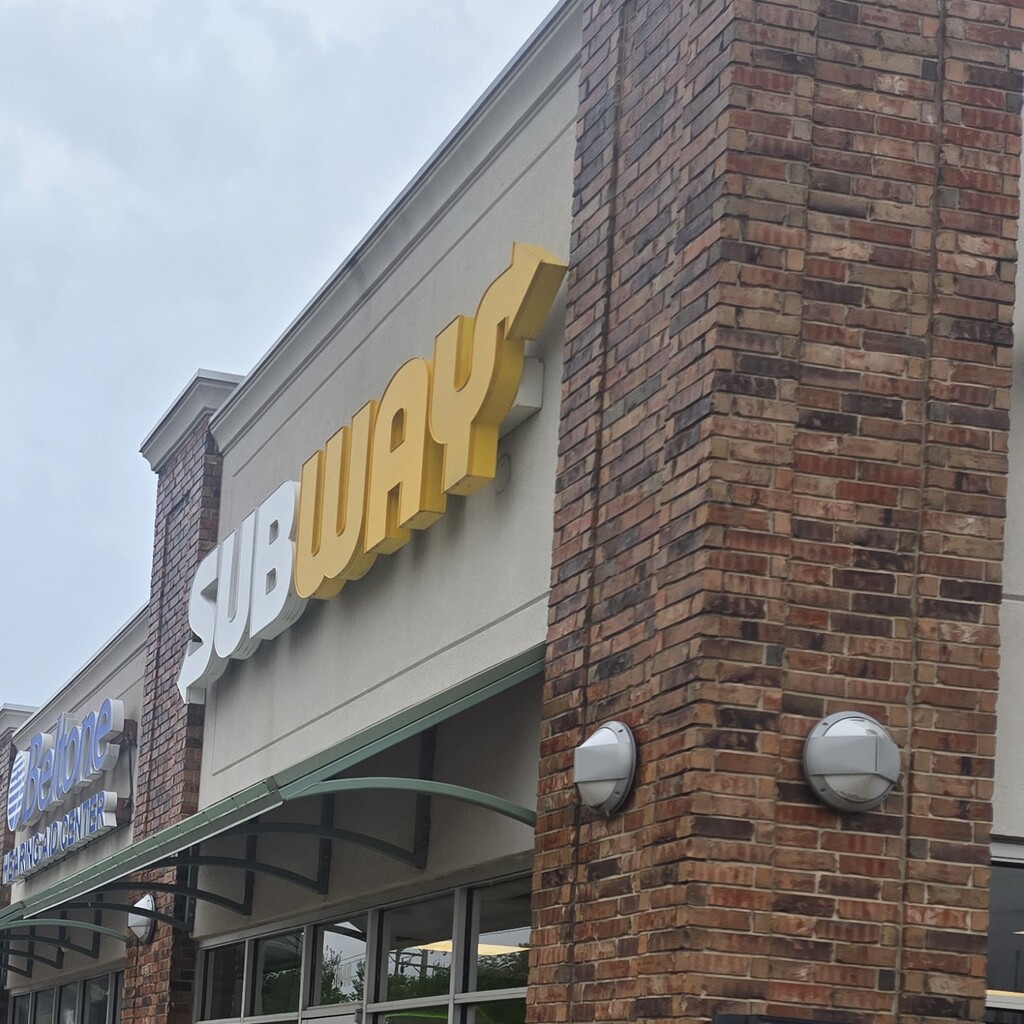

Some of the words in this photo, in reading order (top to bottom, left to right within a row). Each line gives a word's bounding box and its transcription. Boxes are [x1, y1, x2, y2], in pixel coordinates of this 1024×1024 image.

[177, 241, 567, 703] SUBWAY
[22, 697, 124, 827] Beltone
[3, 832, 44, 885] HEARING
[42, 821, 62, 858] AID
[60, 790, 117, 851] CENTER
